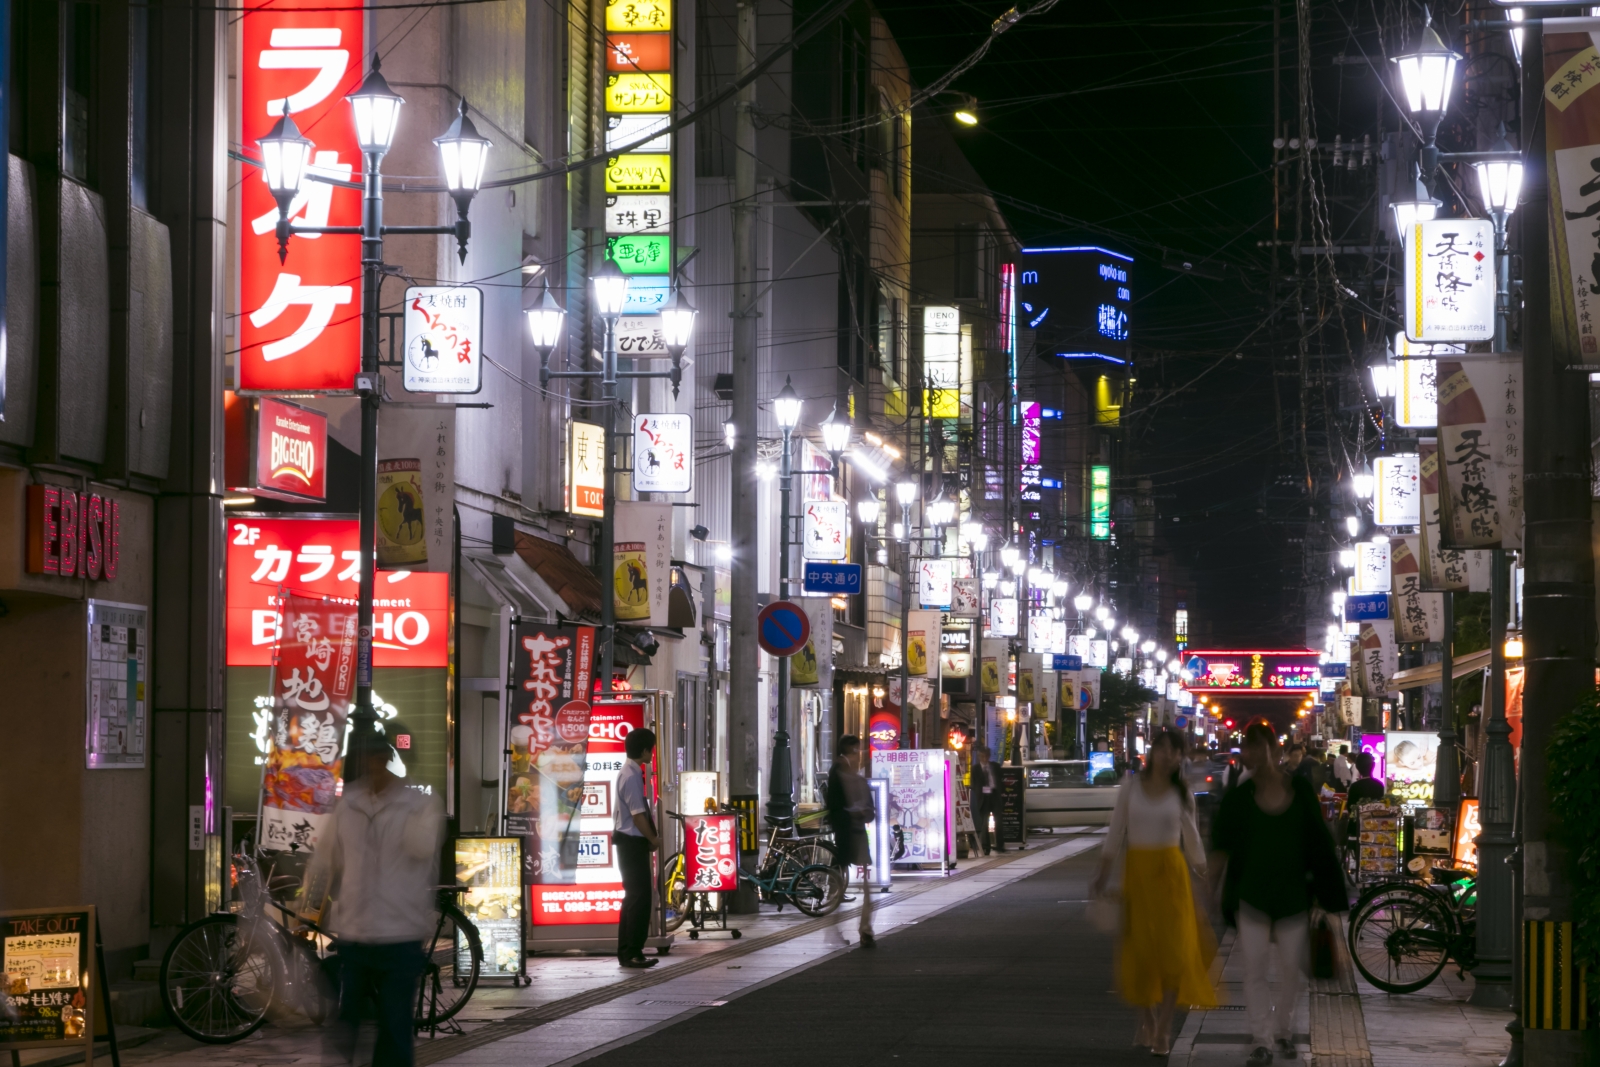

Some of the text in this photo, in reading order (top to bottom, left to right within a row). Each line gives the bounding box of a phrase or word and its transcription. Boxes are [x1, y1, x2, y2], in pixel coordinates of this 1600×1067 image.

[614, 93, 666, 106] サントノーレ
[616, 209, 662, 230] 珠里
[425, 294, 467, 309] 麦焼酎
[929, 312, 955, 320] UENO
[1504, 373, 1518, 458] ふれあいの街
[434, 420, 448, 494] ふれあいの街
[1506, 471, 1519, 520] 中央通り
[44, 485, 120, 583] EBISU
[233, 524, 261, 545] 2F
[433, 505, 445, 547] 中央通り
[655, 514, 667, 569] ふれあいの街
[808, 571, 858, 585] 中央通り
[1346, 600, 1387, 614] 中央通り
[941, 633, 970, 644] OWL
[1055, 657, 1082, 668] 中央通り
[519, 633, 569, 754] だれやめセット
[694, 819, 722, 887] たこ焼
[541, 900, 623, 913] TEL 0985-22-5
[8, 917, 81, 936] TAKE OUT
